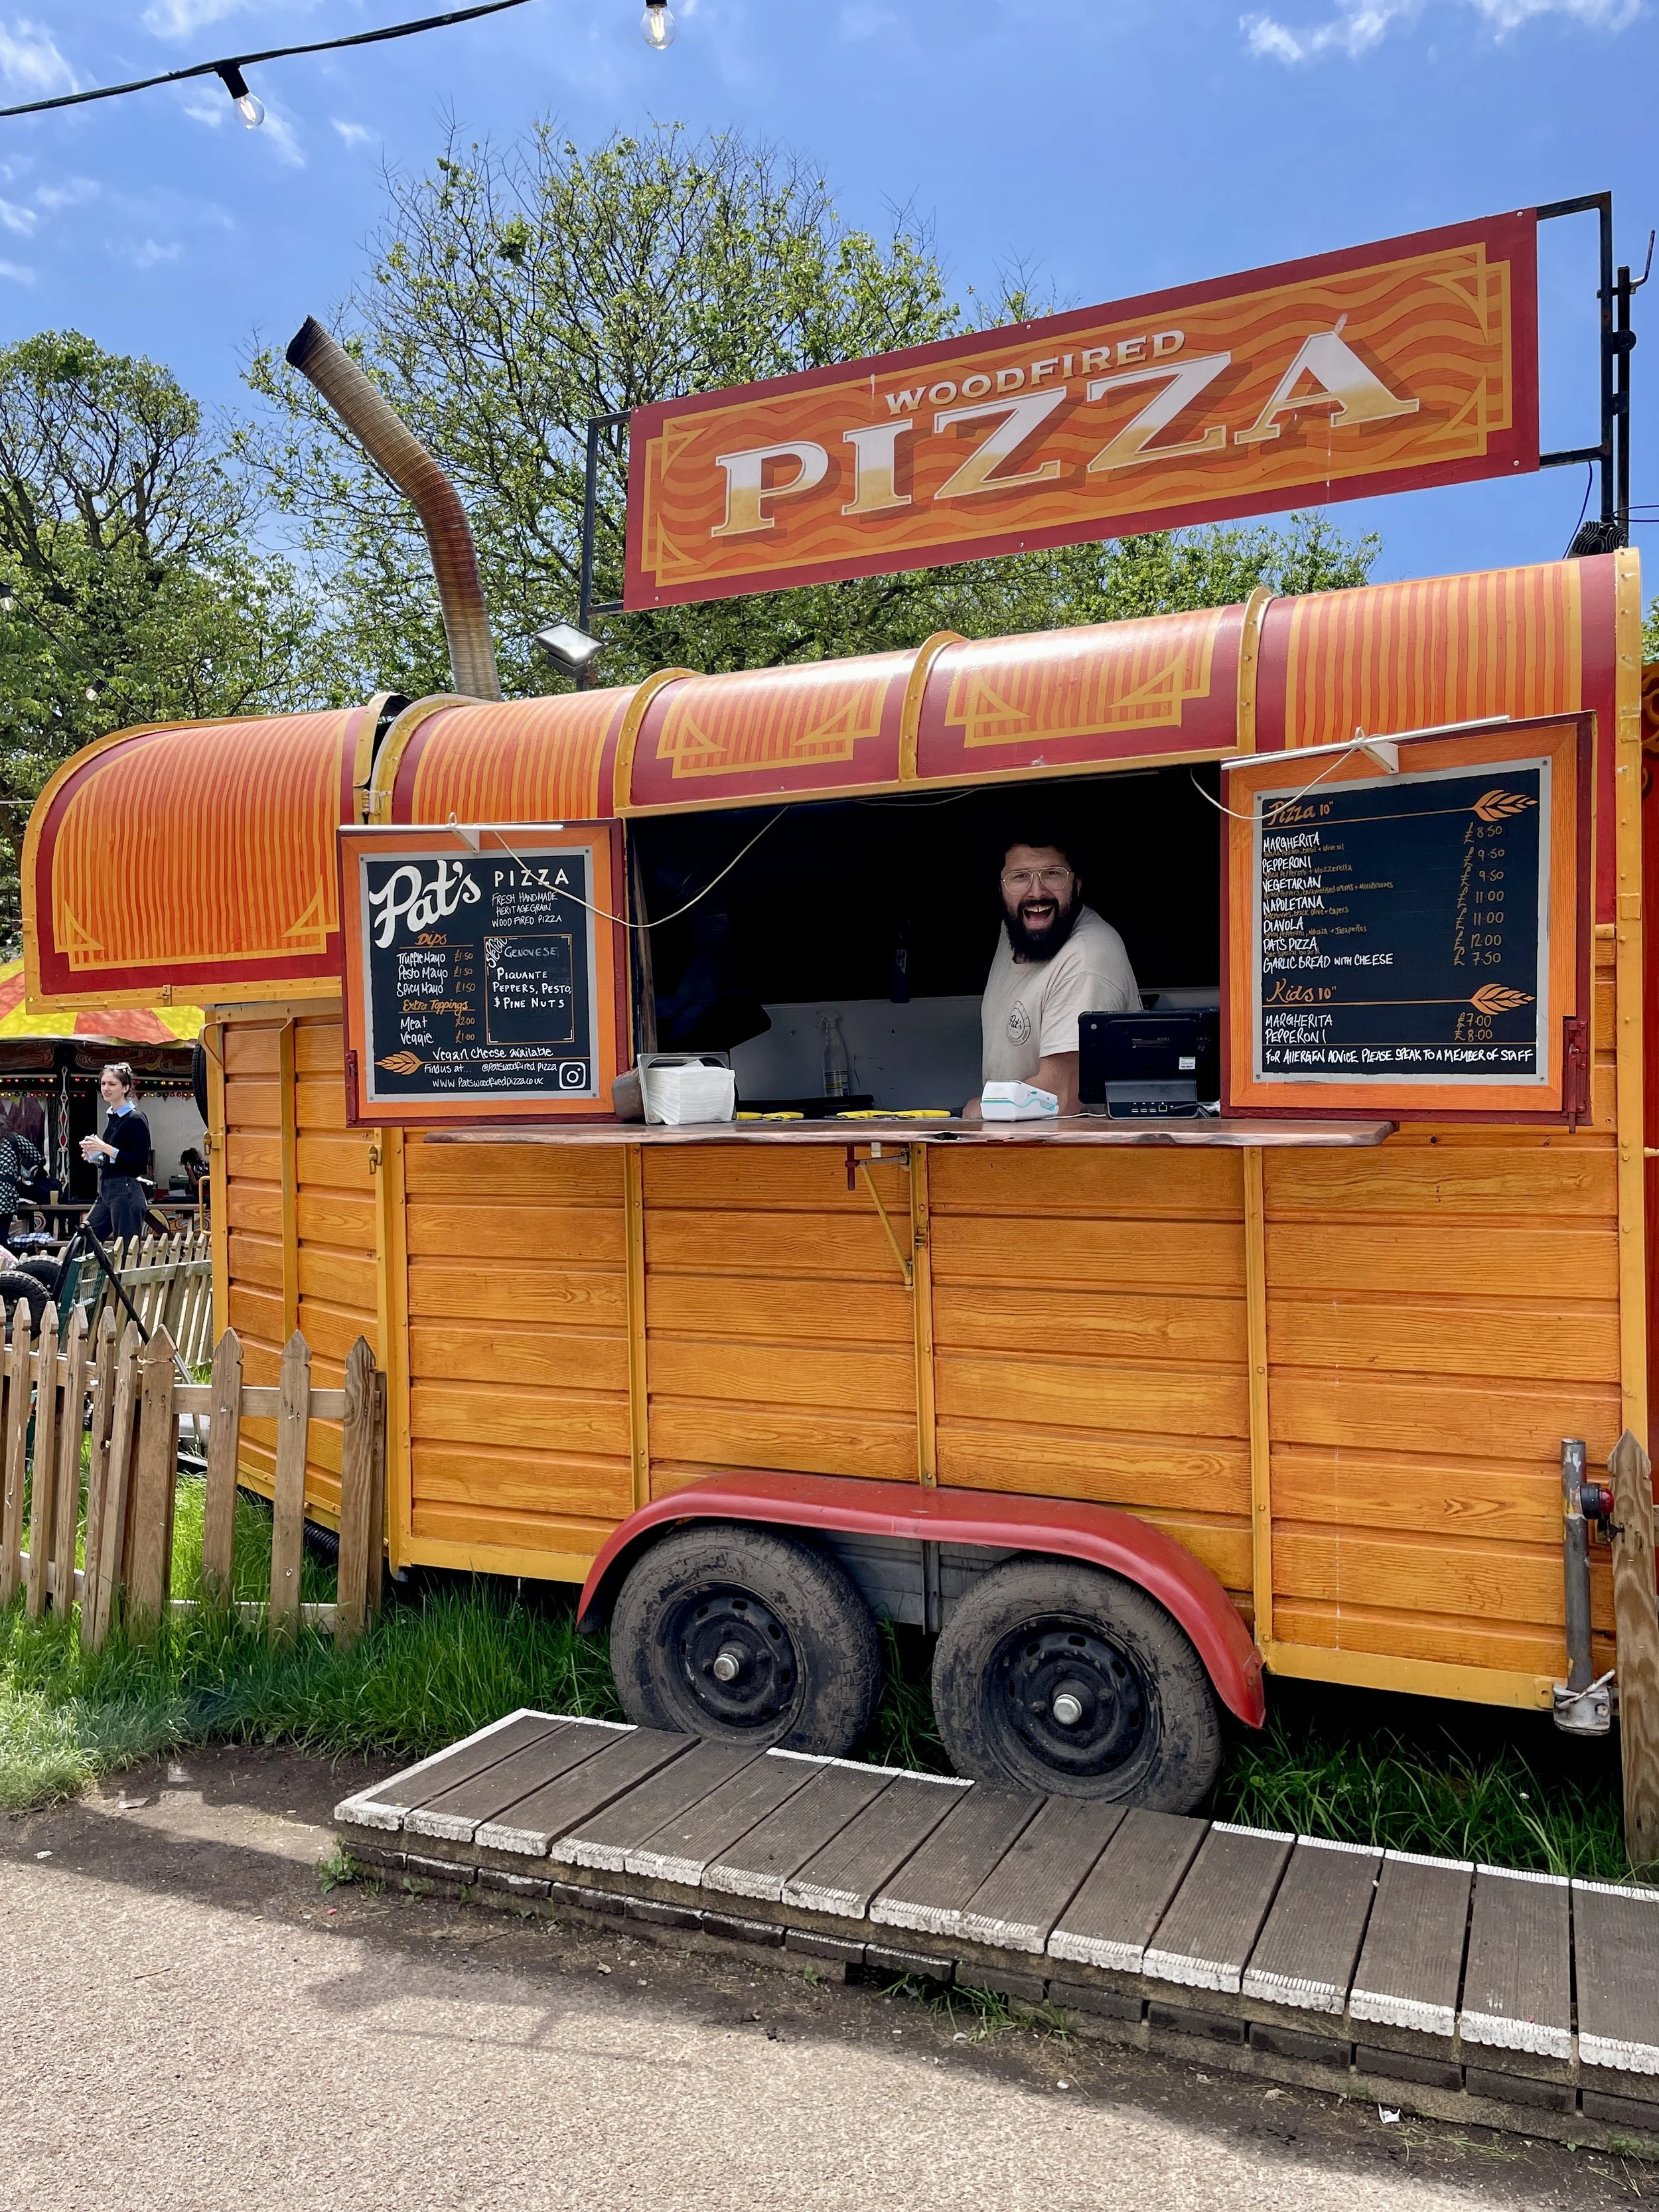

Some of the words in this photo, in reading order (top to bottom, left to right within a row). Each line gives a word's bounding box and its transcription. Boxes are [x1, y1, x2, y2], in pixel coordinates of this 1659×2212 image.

[885, 329, 1185, 416] WOODFIRED
[711, 331, 1420, 538] PIZZA
[1267, 800, 1317, 826] Pizza
[1263, 831, 1321, 853] MARGHERITA
[1262, 855, 1312, 874] PEPPERONI
[494, 868, 569, 887] PIZZA
[1262, 875, 1322, 893] VEGETARIAN
[369, 860, 481, 948] Pat's
[492, 892, 515, 907] FRESH
[519, 891, 559, 903] HANDMADE
[1263, 895, 1325, 915] NAPOLETANA
[496, 903, 530, 917] HERITAGE
[530, 903, 551, 915] GRAIN
[538, 915, 563, 924] PIZZA
[1263, 916, 1304, 933] DIAVOLA
[415, 930, 447, 947] Dips
[1263, 936, 1287, 953] PAT'S
[1289, 936, 1317, 952] PIZZA
[396, 951, 424, 967] Truffle
[424, 951, 446, 967] Mayo
[504, 946, 559, 958] GENOVESE
[1263, 957, 1298, 974] GARLIC
[1298, 956, 1331, 969] BREAD
[1334, 956, 1352, 966] WITH
[1354, 953, 1394, 966] CHEESE
[399, 964, 420, 981] Pesto
[422, 966, 449, 984] Mayo
[496, 967, 548, 981] PIQUANTE
[396, 982, 420, 997] Spicy
[421, 982, 443, 996] Mayo
[492, 982, 539, 994] PEPPERS,
[541, 983, 572, 994] PESTO,
[1266, 978, 1315, 1003] Kids
[402, 999, 427, 1011] Extra
[429, 998, 469, 1016] Toppings
[503, 997, 526, 1009] PINE
[532, 997, 565, 1008] NUTS
[400, 1016, 428, 1032] Meat
[1265, 1013, 1333, 1028] MARGHERITA
[400, 1031, 434, 1047] Veggie
[1265, 1027, 1327, 1045] PEPPERONI
[433, 1047, 469, 1061] Vegan
[509, 1047, 554, 1059] available
[1265, 1049, 1281, 1065] FOR
[1327, 1049, 1359, 1063] ADVICE
[1361, 1048, 1394, 1063] PLEASE
[1394, 1047, 1422, 1062] SPEAK
[1423, 1049, 1435, 1061] TO
[1435, 1049, 1443, 1061] A
[1444, 1048, 1486, 1063] MEMBER
[1486, 1048, 1499, 1061] OF
[1500, 1049, 1534, 1062] STAFF
